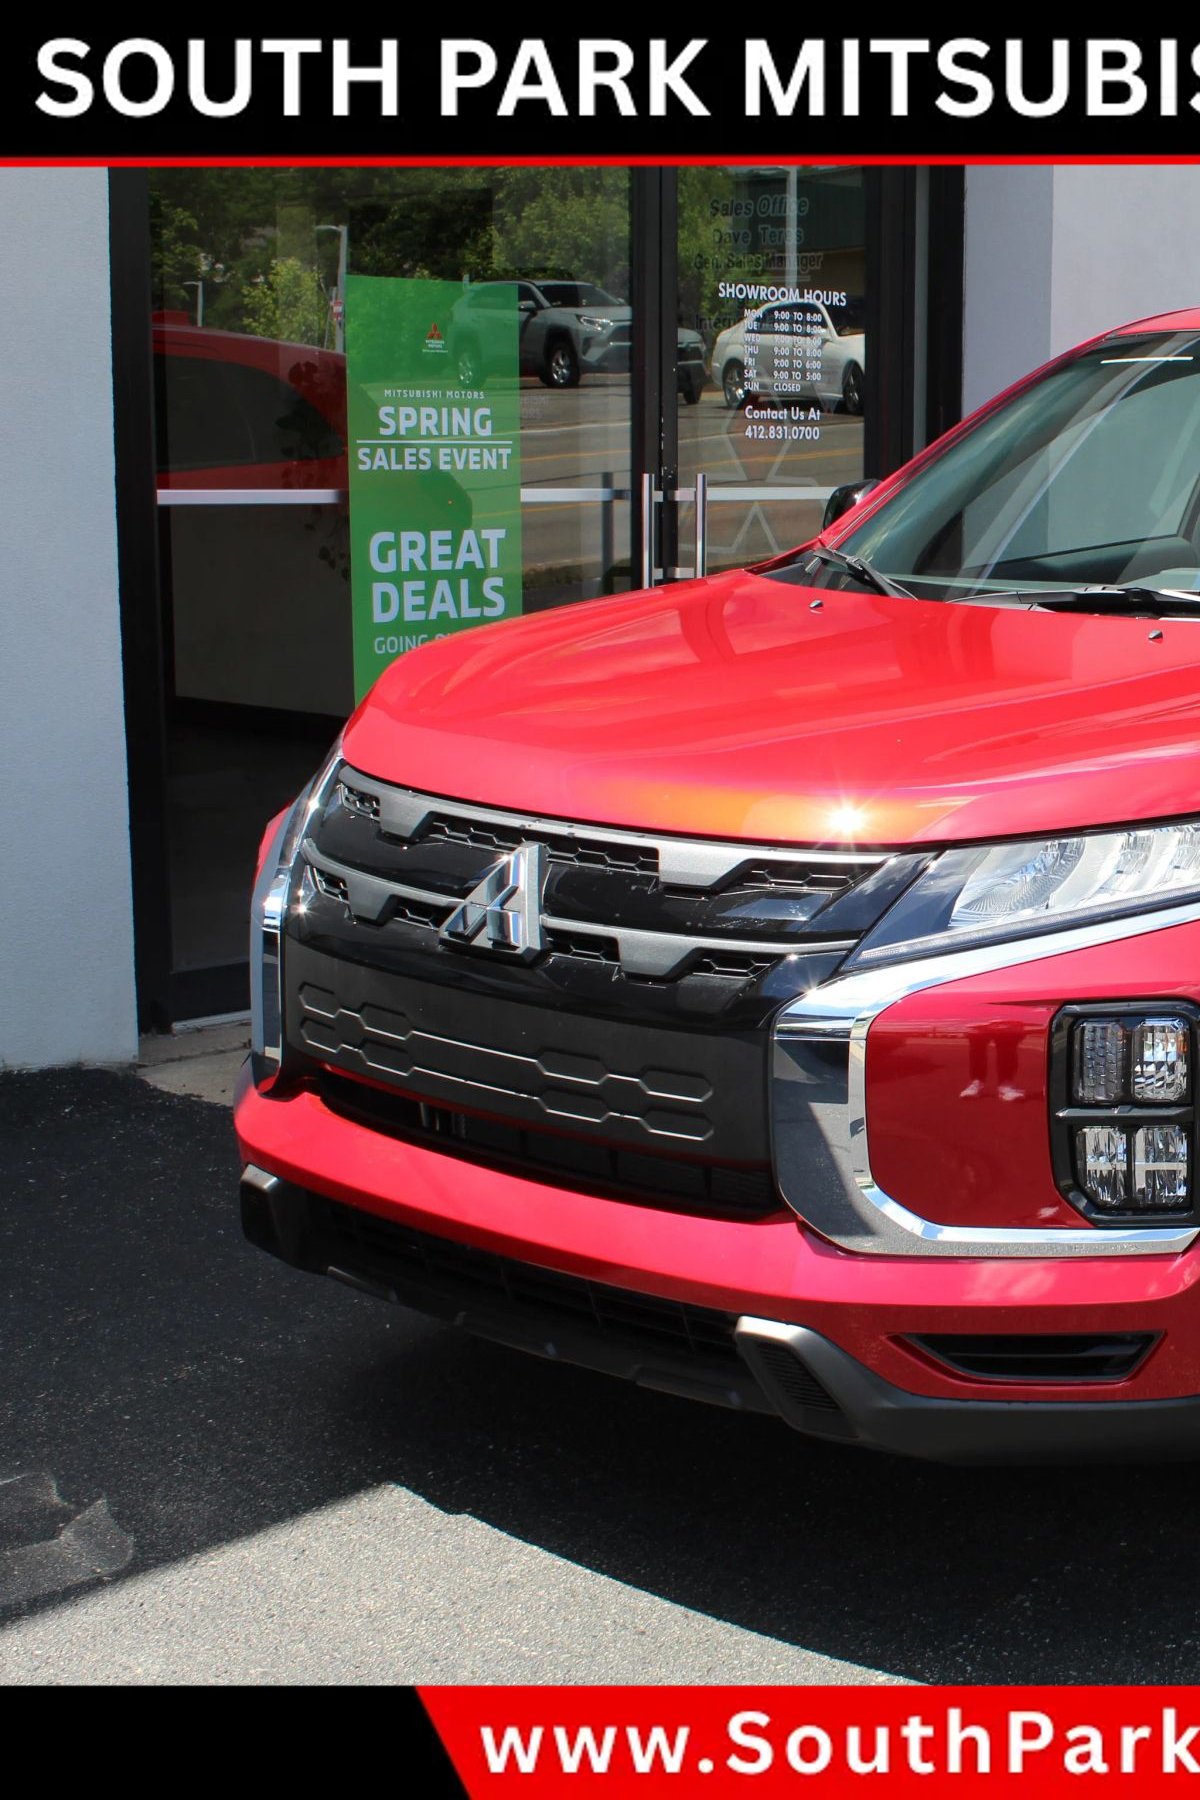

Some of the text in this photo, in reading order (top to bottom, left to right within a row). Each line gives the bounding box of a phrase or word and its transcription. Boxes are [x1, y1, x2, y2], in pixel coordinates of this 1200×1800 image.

[710, 199, 753, 217] Sales
[764, 251, 825, 272] Mager
[718, 282, 847, 306] SHOWROOM HOURS
[744, 309, 822, 322] MON 9:00 TO 8:00
[744, 321, 758, 330] TUE
[774, 323, 789, 331] 9:00
[793, 324, 803, 332] TO
[744, 345, 759, 354] THU
[774, 347, 789, 355] 9:00
[793, 348, 803, 357] TO
[744, 358, 755, 366] FRI
[774, 359, 789, 368] 9:00
[793, 360, 802, 368] TO
[744, 369, 821, 380] SAT 9:00 TO 5:00
[384, 389, 485, 399] MITSUBISHI MOTORS
[744, 382, 800, 392] SUN CLOSED
[745, 405, 820, 420] Contact Us At
[378, 406, 492, 436] SPRING
[745, 425, 820, 439] 412.831.0700
[357, 447, 512, 471] SALES EVENT
[369, 529, 506, 574] GREAT
[371, 577, 506, 624] DEALS
